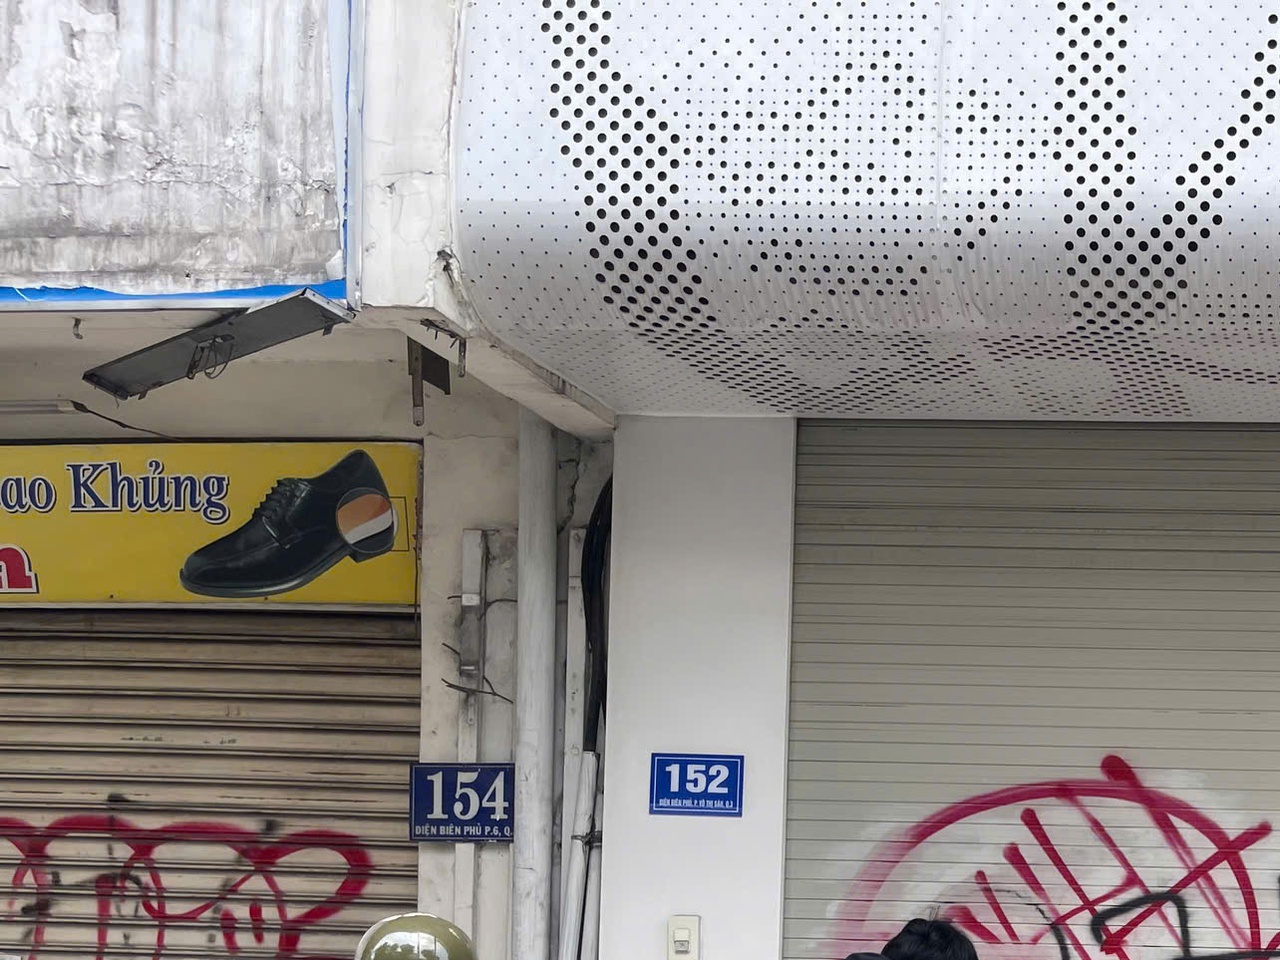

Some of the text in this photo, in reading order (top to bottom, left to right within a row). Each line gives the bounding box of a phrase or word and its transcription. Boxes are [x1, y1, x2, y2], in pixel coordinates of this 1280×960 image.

[66, 459, 229, 523] Khủng
[427, 771, 509, 820] 154
[665, 763, 729, 793] 152
[439, 823, 461, 836] BIÊN
